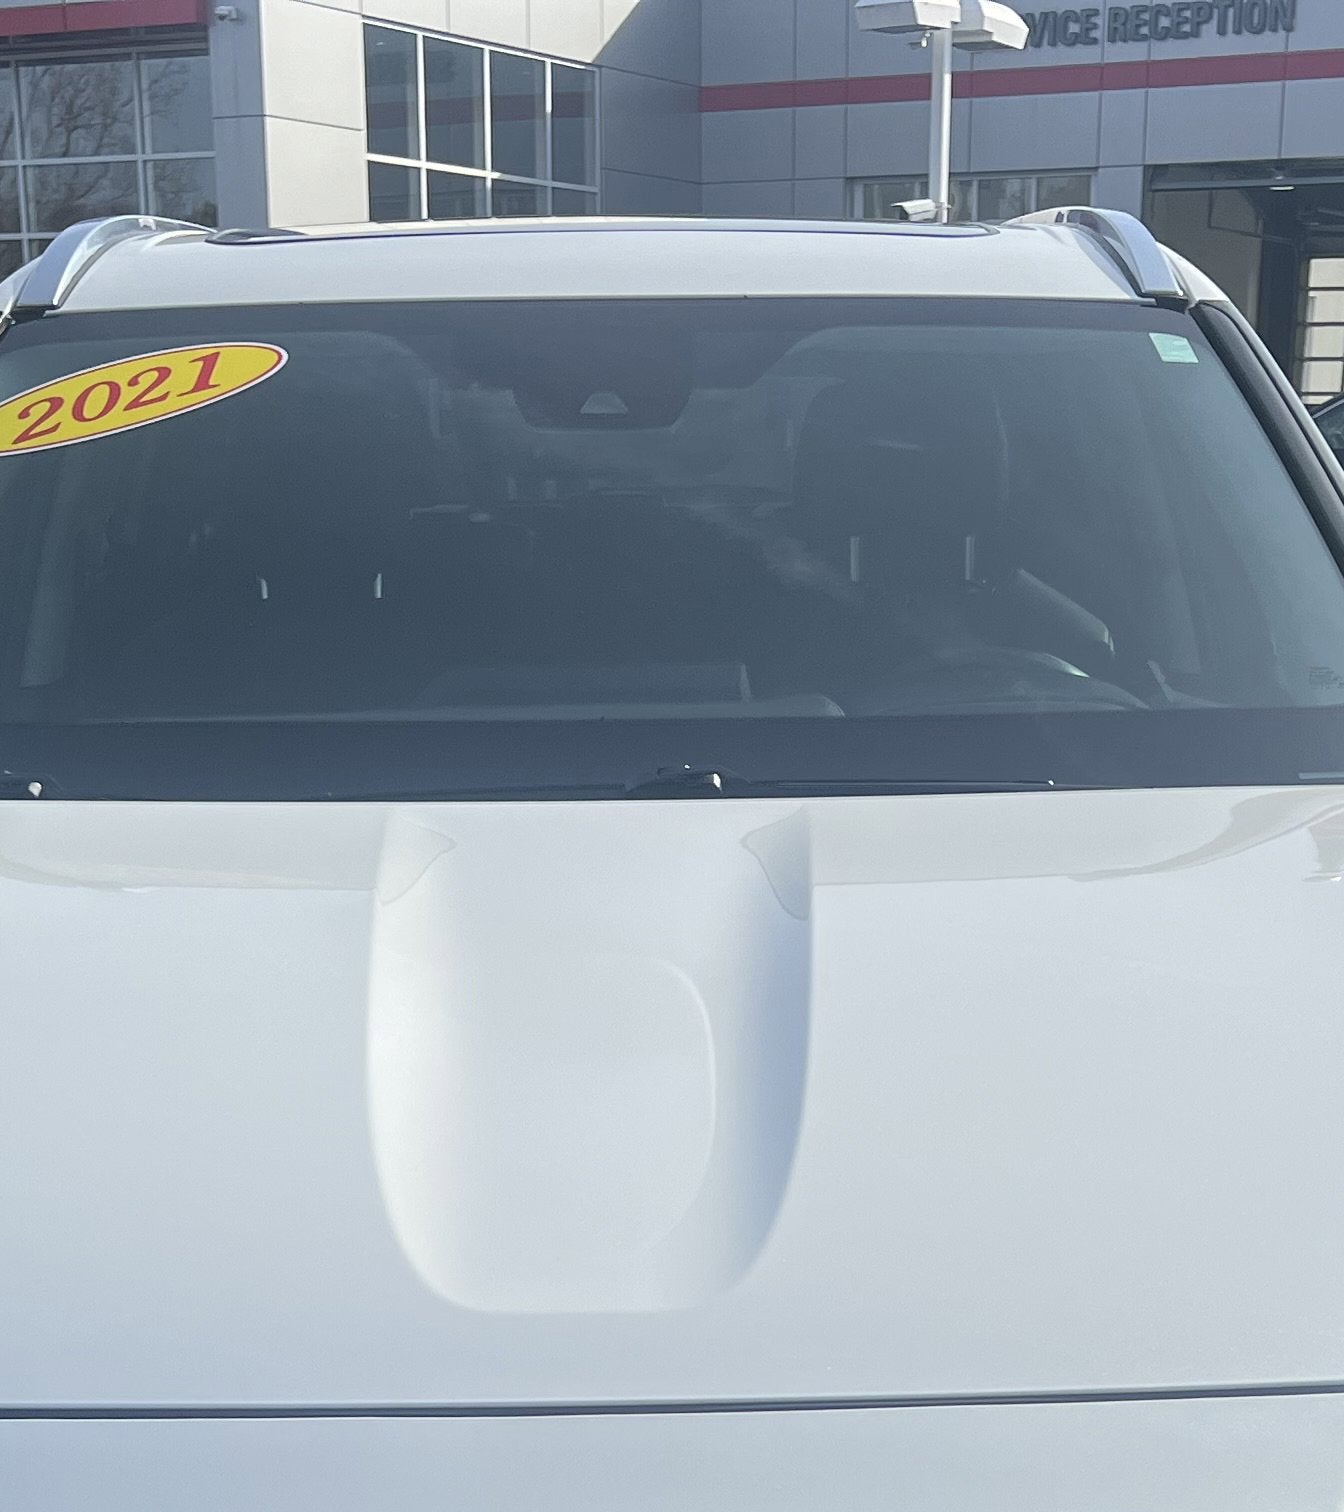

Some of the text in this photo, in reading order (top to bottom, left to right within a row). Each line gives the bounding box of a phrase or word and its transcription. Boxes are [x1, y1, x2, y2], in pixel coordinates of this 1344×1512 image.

[1024, 0, 1297, 48] VICE RECEPTION
[11, 351, 222, 445] 2021
